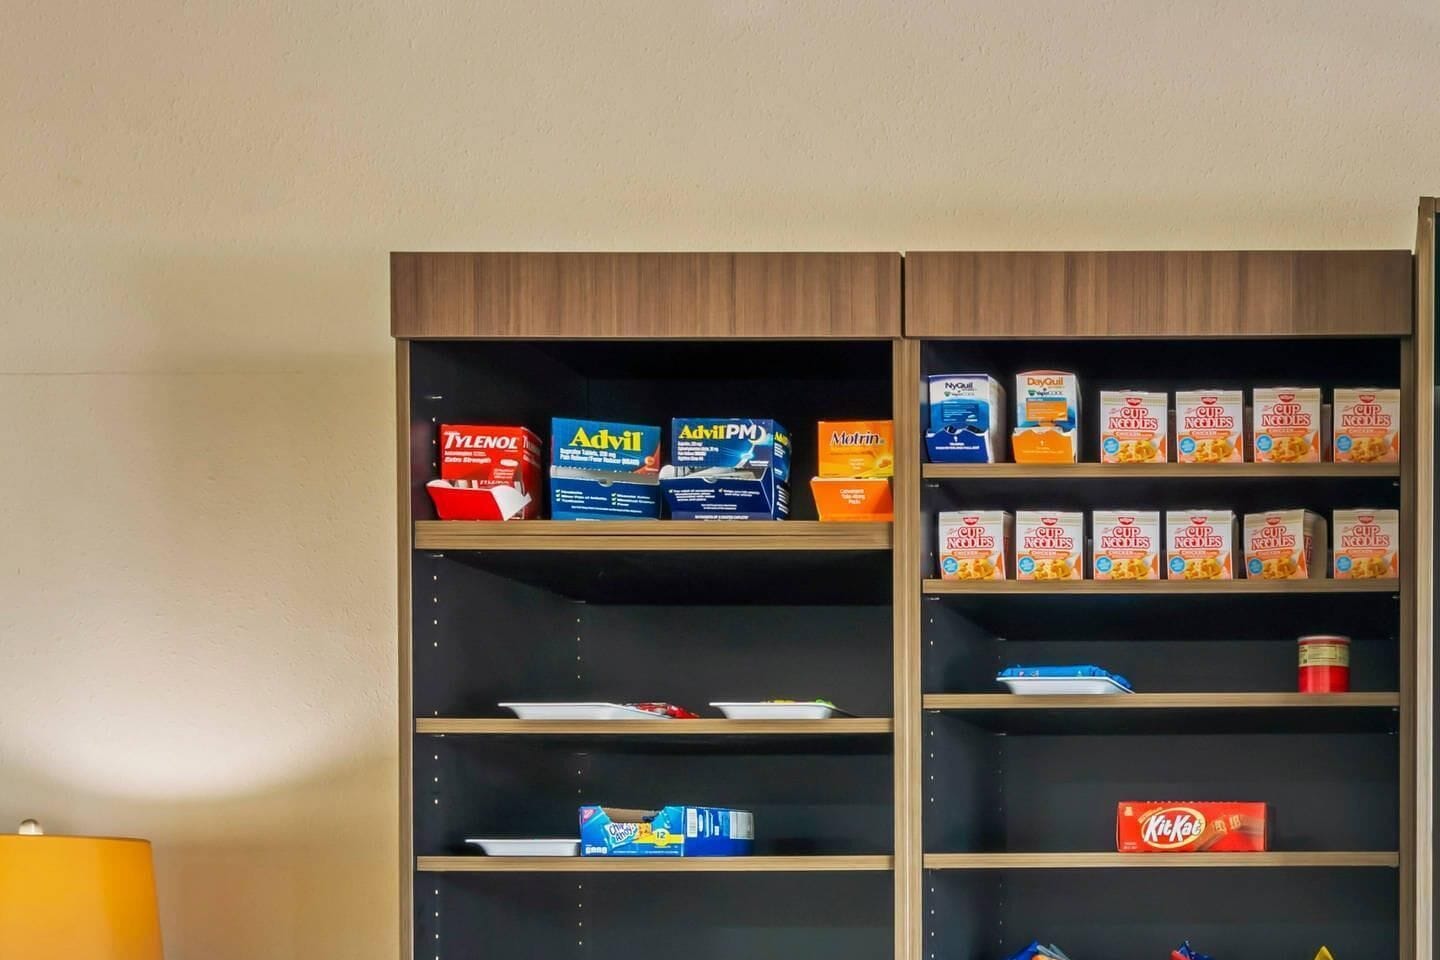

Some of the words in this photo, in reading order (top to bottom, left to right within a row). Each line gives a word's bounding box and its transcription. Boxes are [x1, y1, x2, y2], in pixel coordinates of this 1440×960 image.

[945, 382, 974, 391] NyQuil
[1027, 377, 1064, 388] DayQuil
[1120, 407, 1149, 419] CUP
[1196, 406, 1224, 418] CUP
[1273, 404, 1301, 416] CUP
[1353, 404, 1382, 416] CUP
[1109, 417, 1159, 431] NOODLES
[1184, 416, 1233, 430] NOODLES
[1262, 414, 1311, 427] NOODLES
[1342, 414, 1392, 427] NOODLES
[679, 424, 726, 440] Advil
[726, 424, 757, 440] PM
[831, 431, 880, 446] Motrin
[444, 431, 519, 449] TYLENOL
[568, 427, 642, 451] Advil
[958, 527, 985, 538] CUP
[1035, 527, 1064, 538] CUP
[1113, 526, 1141, 538] CUP
[1185, 526, 1213, 538] CUP
[1261, 526, 1287, 539] CUP
[1352, 525, 1380, 537] CUP
[947, 536, 994, 549] NOODLES
[1024, 537, 1073, 550] NOODLES
[1101, 536, 1151, 549] NOODLES
[1175, 536, 1223, 549] NOODLES
[1252, 535, 1296, 550] NOODLES
[1341, 535, 1390, 548] NOODLES
[655, 831, 666, 839] 12
